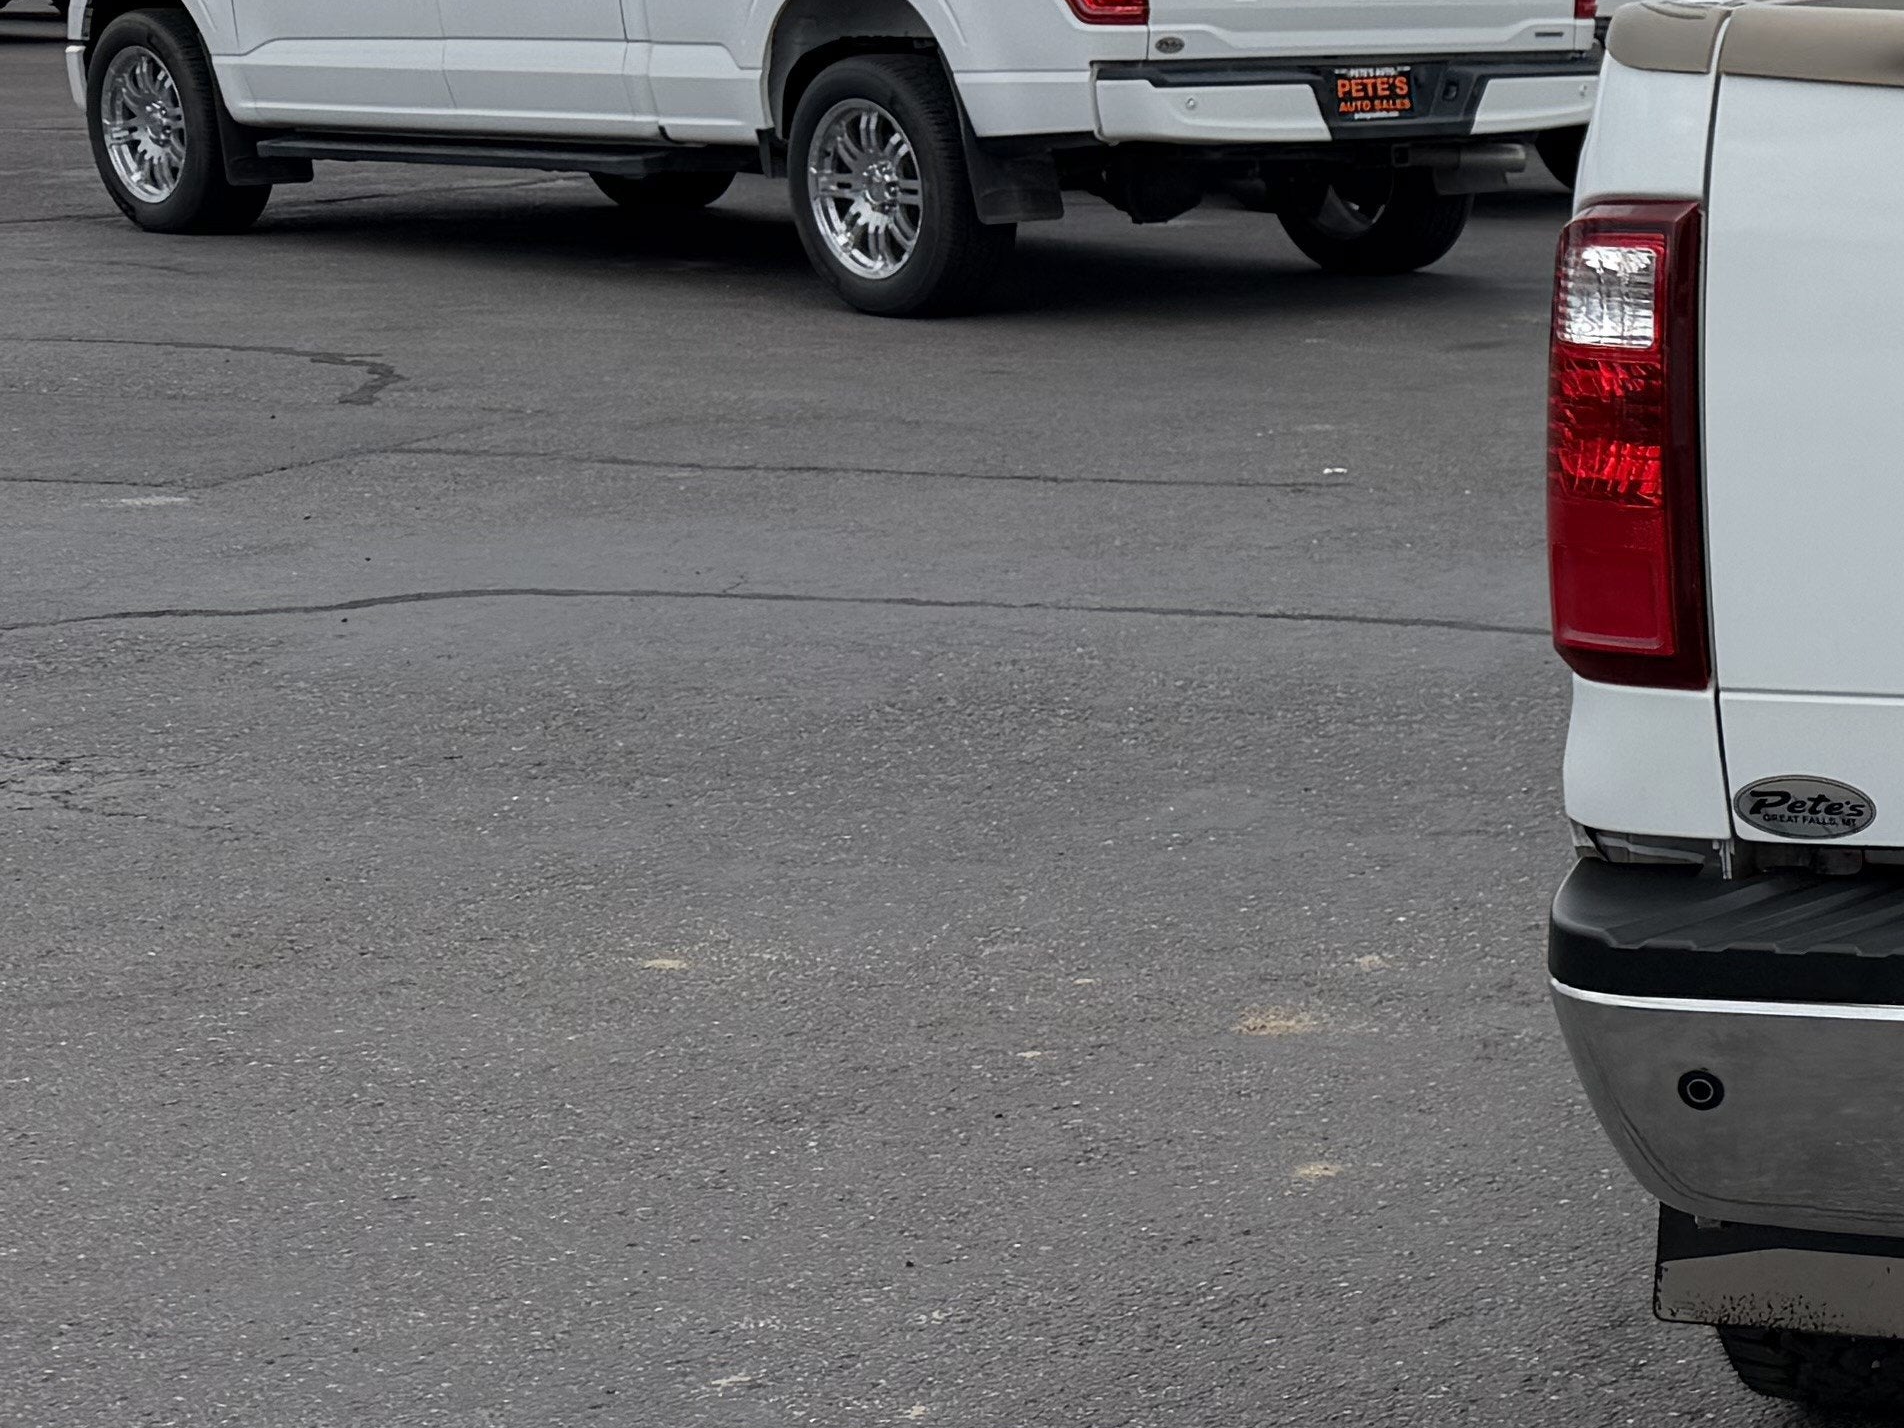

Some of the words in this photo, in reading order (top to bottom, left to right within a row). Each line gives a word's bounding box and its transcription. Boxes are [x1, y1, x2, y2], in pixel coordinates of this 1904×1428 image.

[1337, 76, 1409, 98] PETE'S
[1339, 100, 1371, 112] AUTO
[1749, 790, 1866, 817] Pete's
